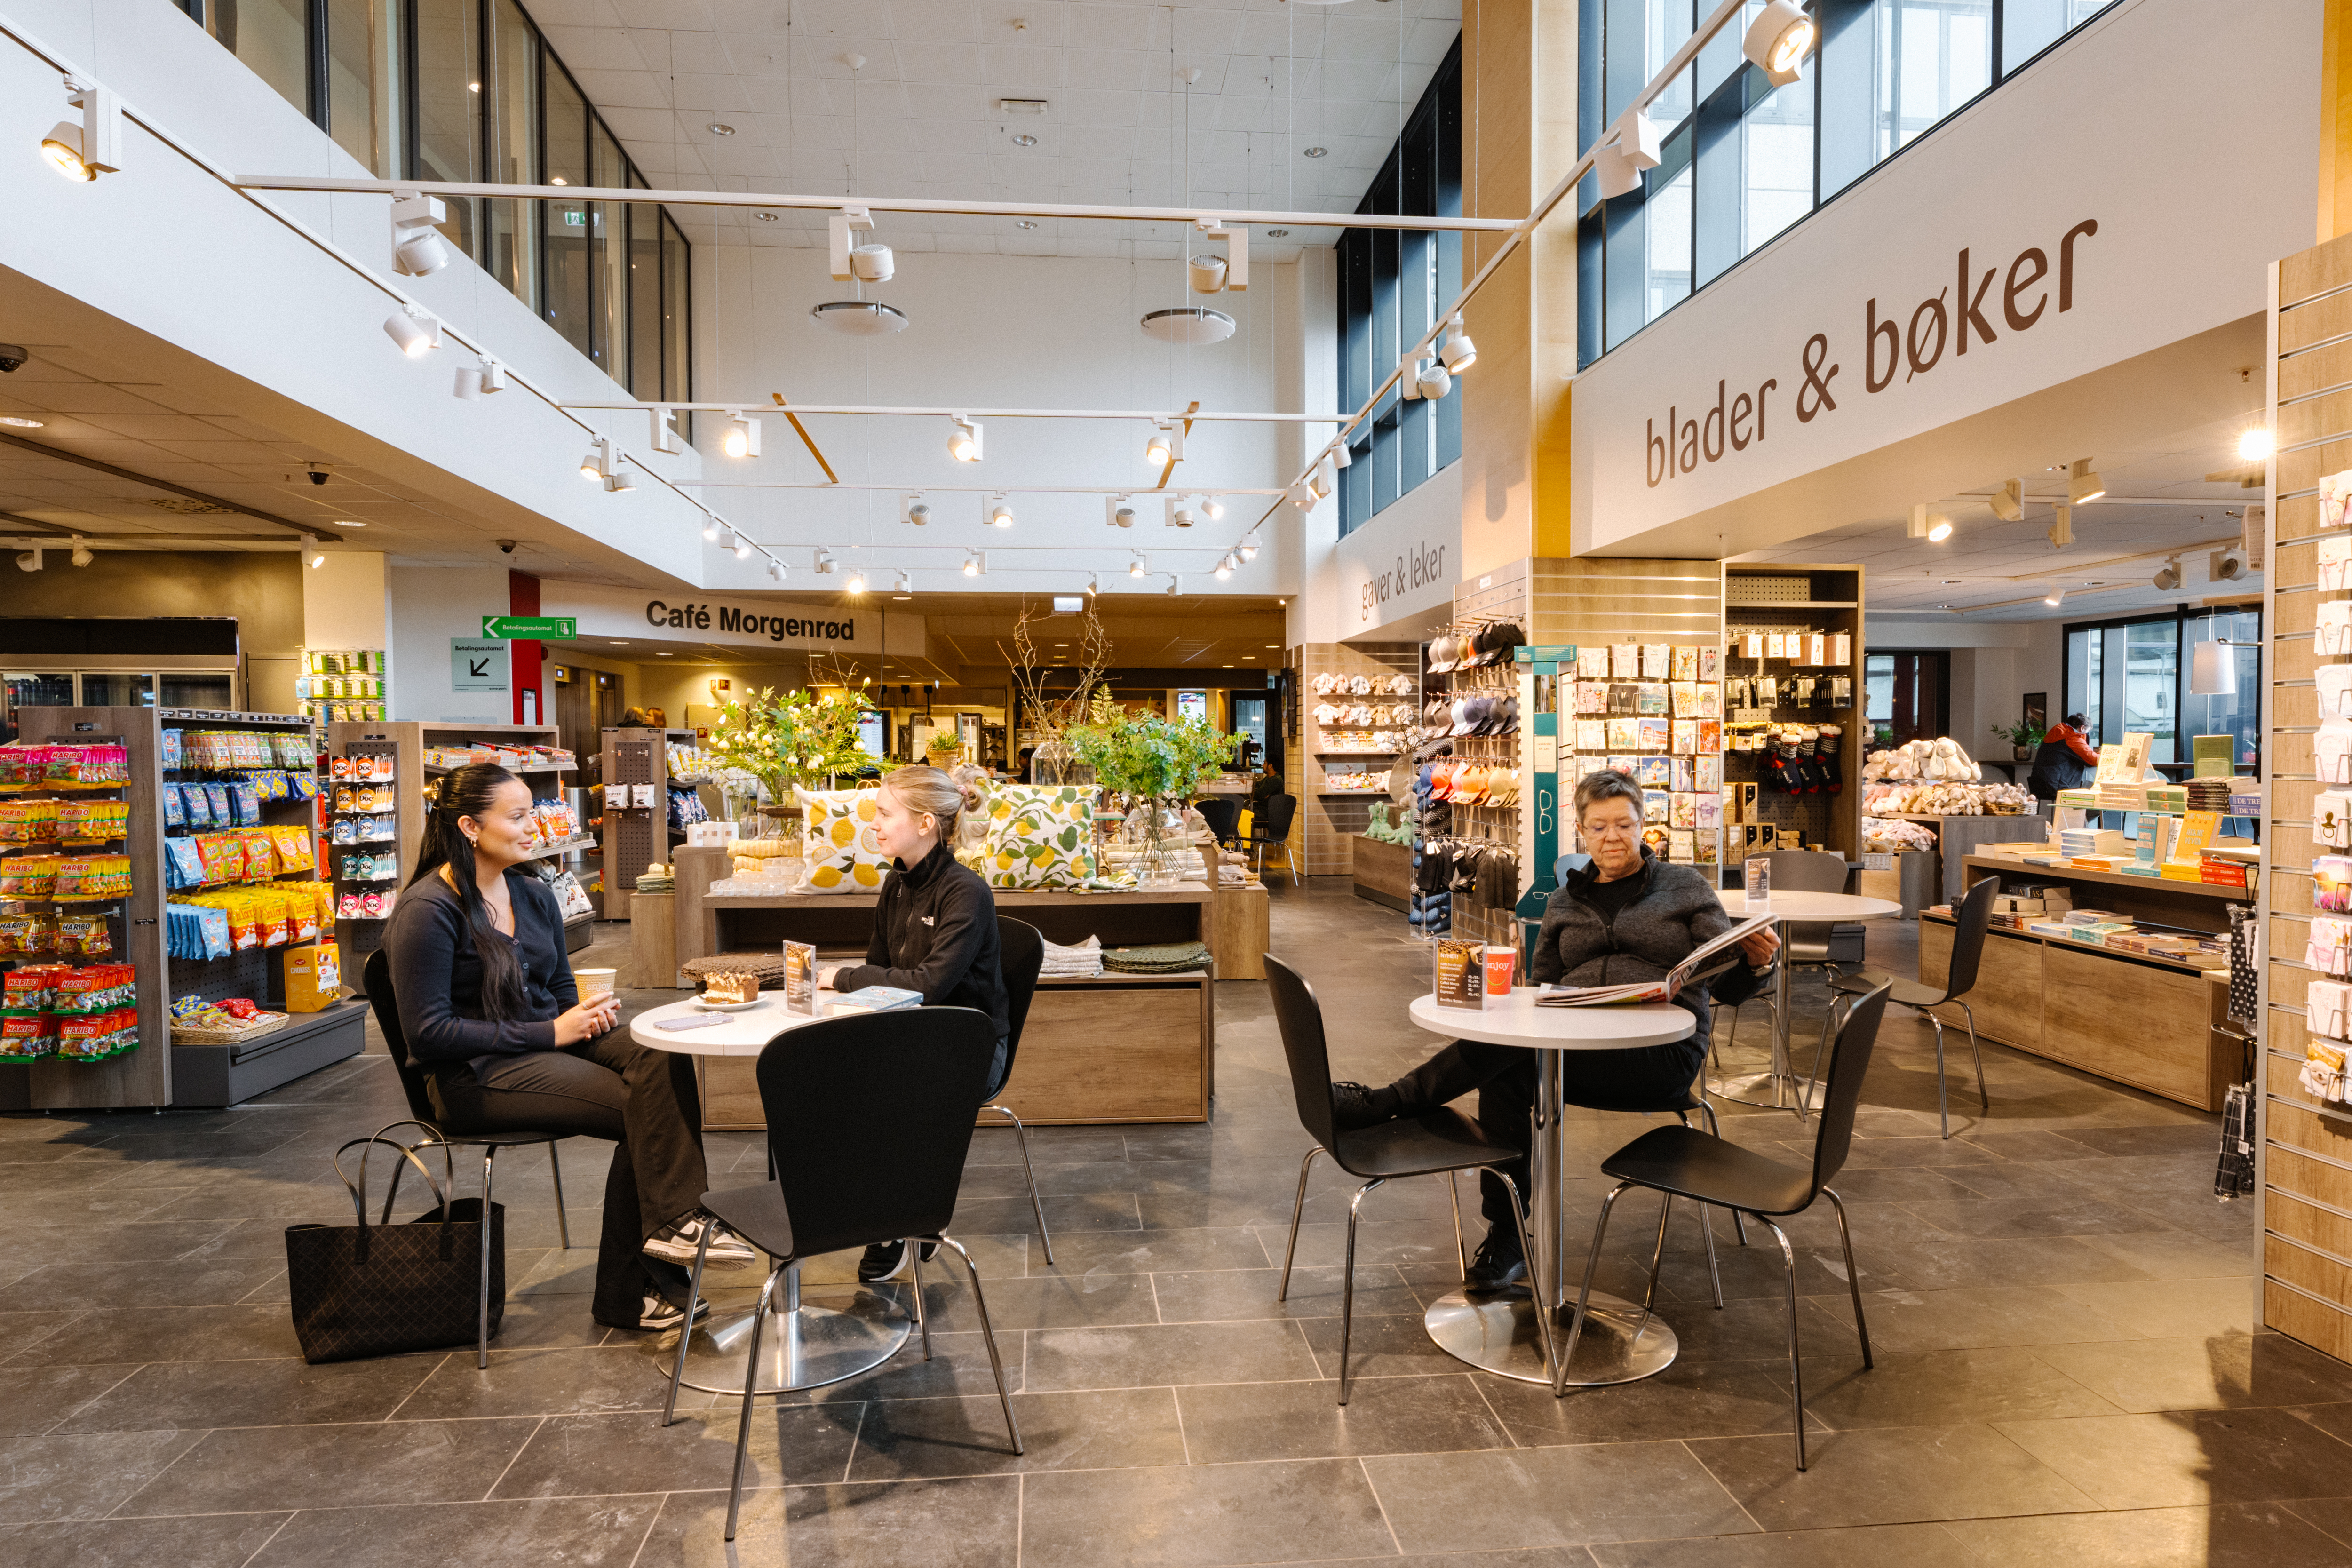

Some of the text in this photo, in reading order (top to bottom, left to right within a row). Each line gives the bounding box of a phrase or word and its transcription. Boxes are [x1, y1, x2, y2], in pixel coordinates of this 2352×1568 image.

[1647, 218, 2098, 488] blader & bøker
[1362, 541, 1445, 621] gaver & leker
[646, 600, 854, 642] Café Morgenrød
[2123, 737, 2142, 747] FARS
[294, 900, 314, 914] bilar
[236, 908, 254, 922] bilar
[266, 906, 286, 919] bilar
[0, 921, 30, 930] HARIBO
[62, 923, 91, 931] HARIBO
[1486, 962, 1510, 971] enjoy
[8, 978, 39, 987] HARIBO
[323, 973, 335, 983] CHOKISS
[586, 982, 612, 992] enjoy
[6, 1024, 38, 1033] HARIBO
[64, 1026, 96, 1035] HARIBO
